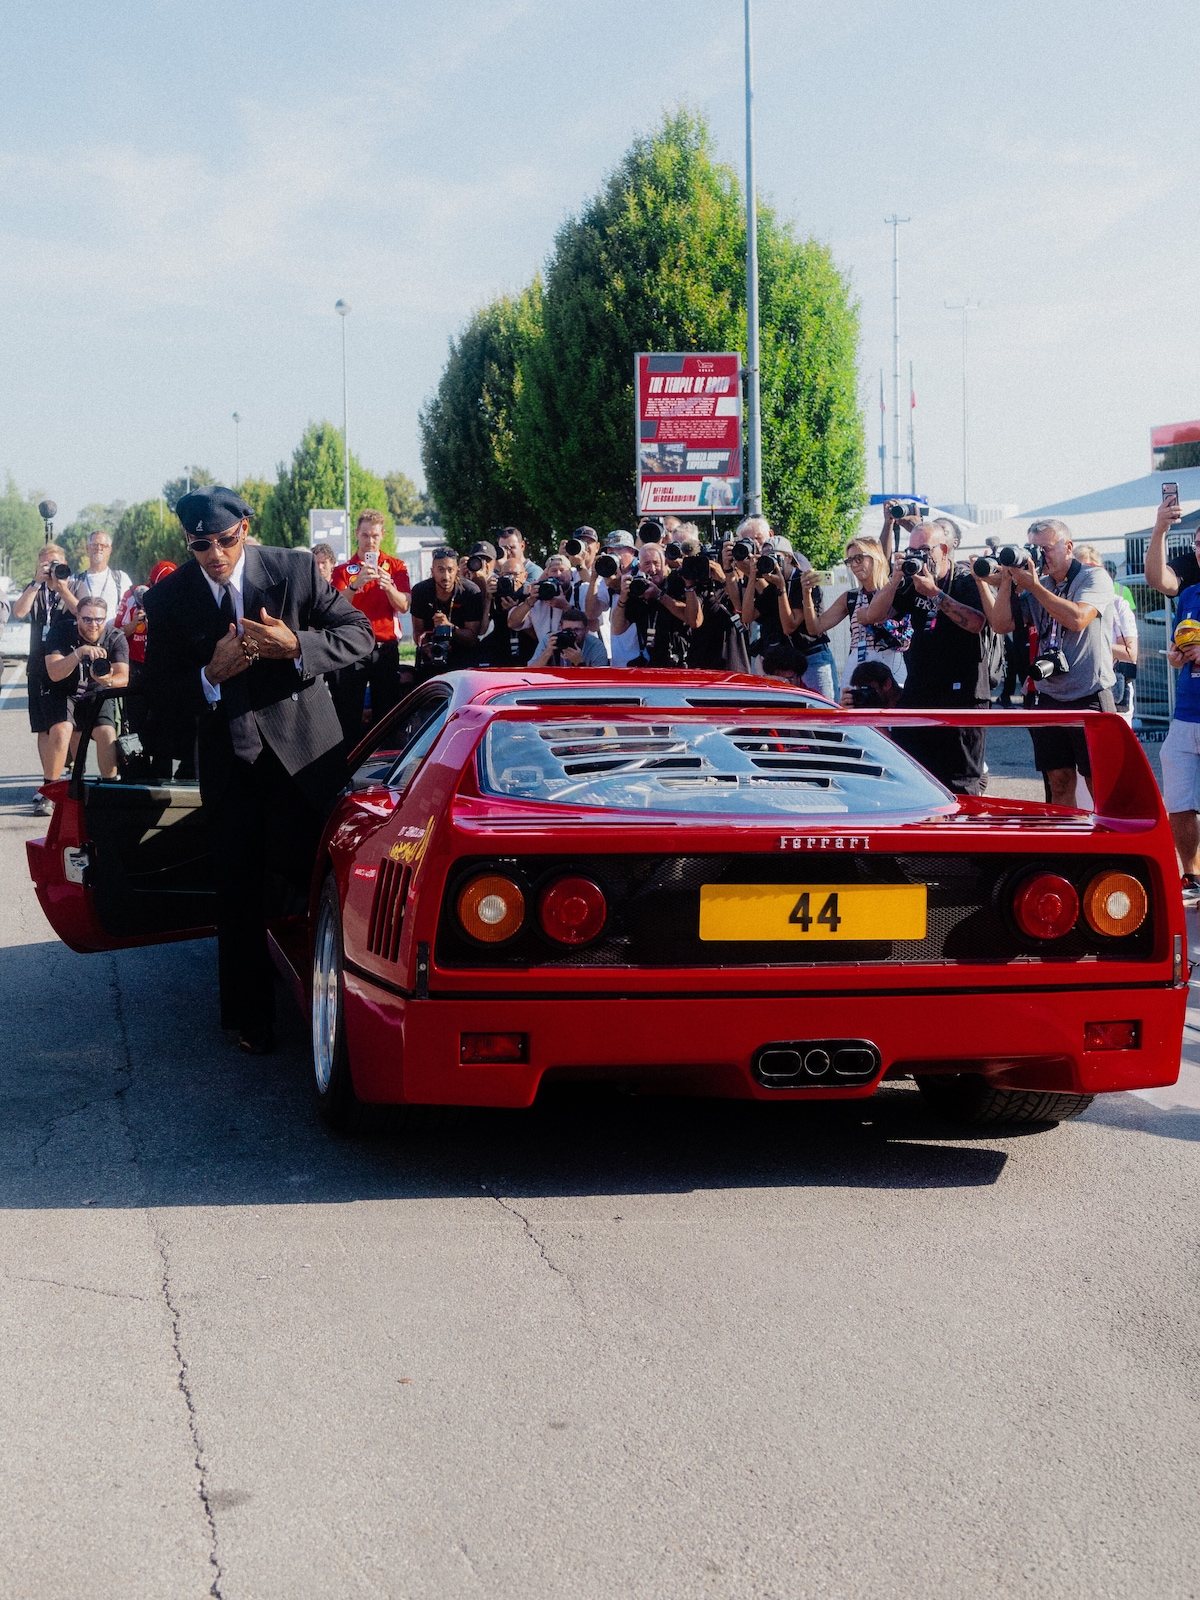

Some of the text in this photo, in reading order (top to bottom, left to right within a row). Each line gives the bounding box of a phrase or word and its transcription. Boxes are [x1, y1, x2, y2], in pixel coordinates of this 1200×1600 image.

[649, 376, 730, 393] THE TEMPLE OF SPEED
[652, 486, 675, 495] OFFICIAL
[652, 494, 697, 503] MERCHANDISING
[780, 835, 870, 849] Ferrari
[788, 892, 842, 933] 44
